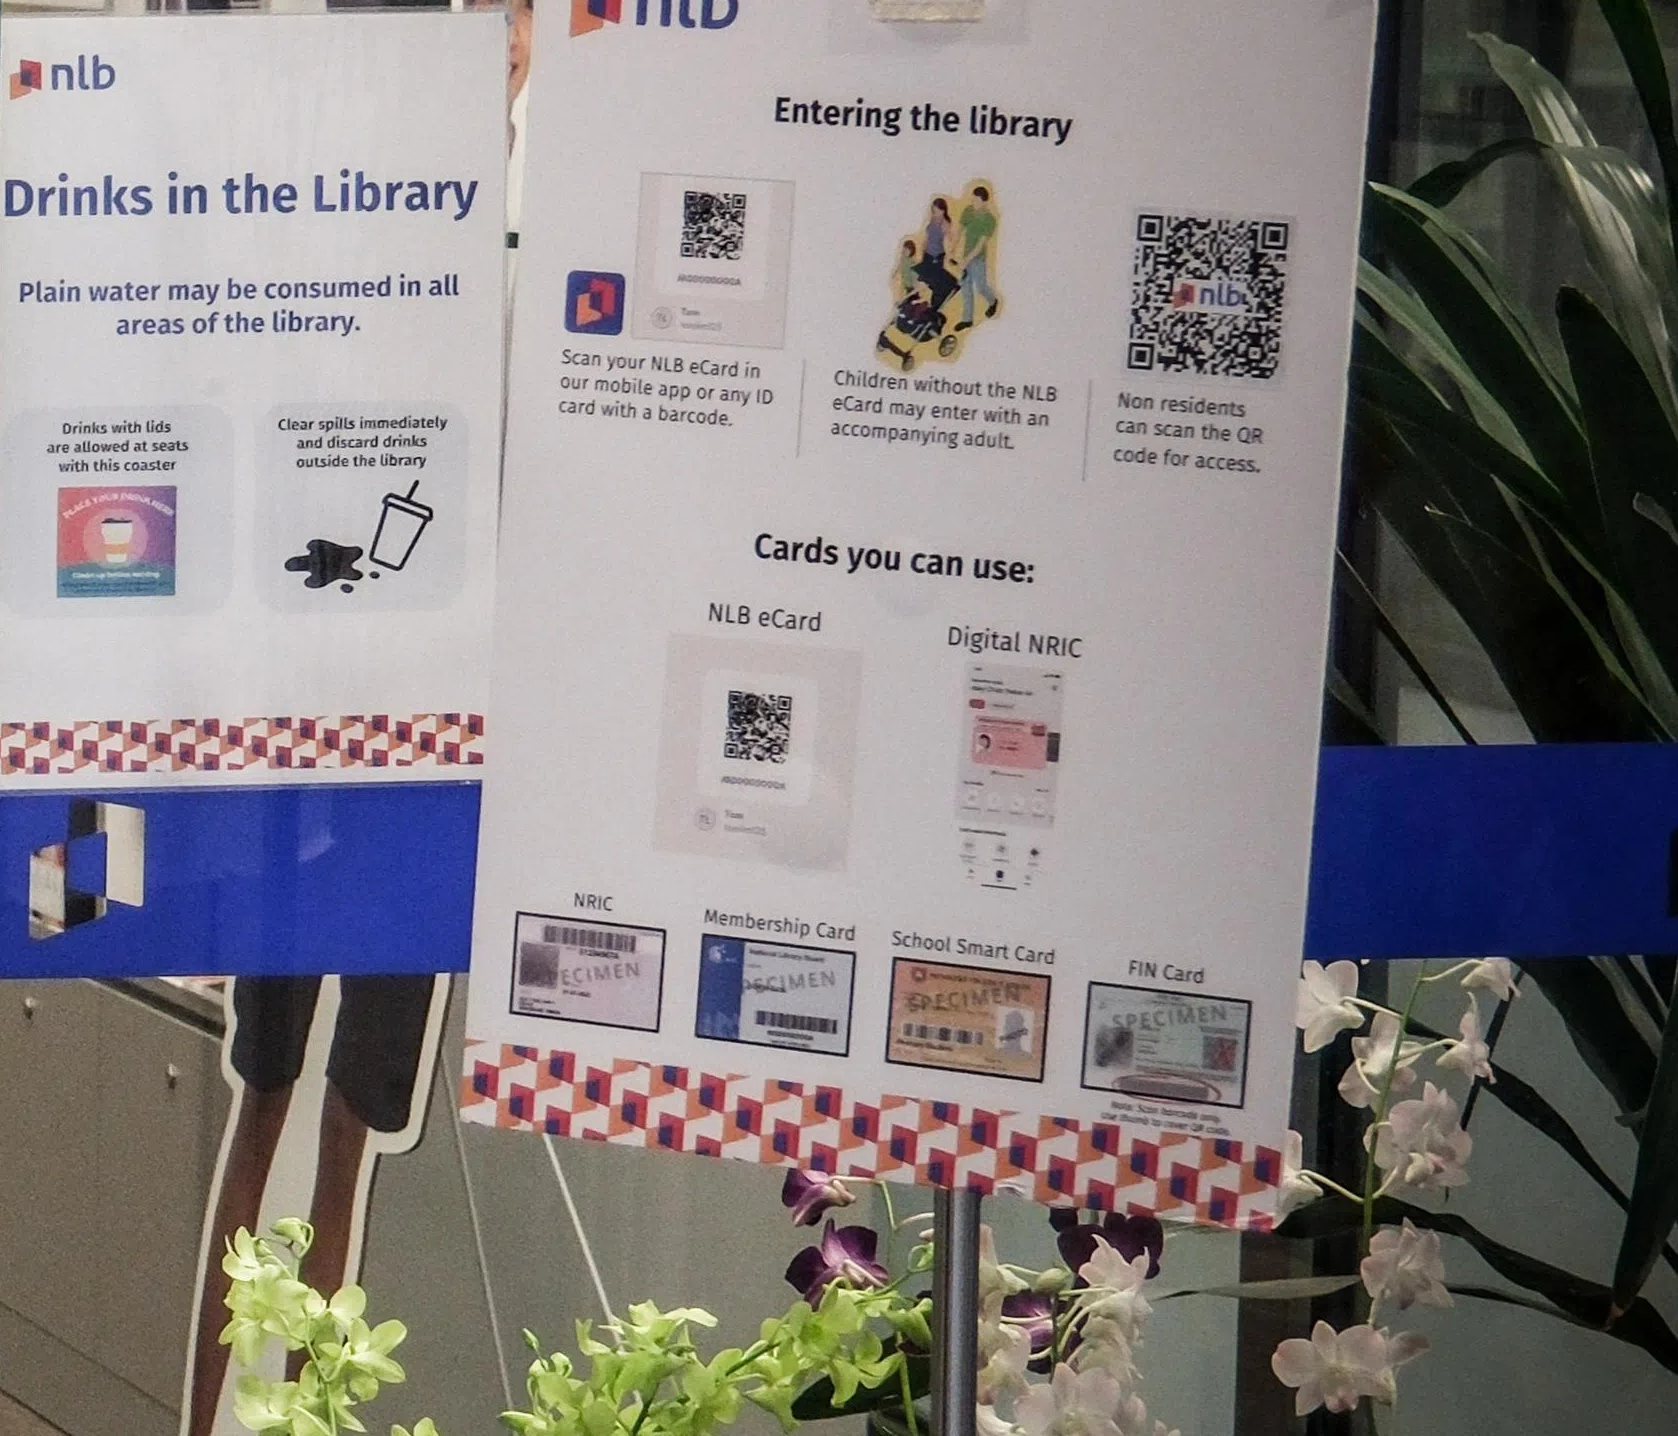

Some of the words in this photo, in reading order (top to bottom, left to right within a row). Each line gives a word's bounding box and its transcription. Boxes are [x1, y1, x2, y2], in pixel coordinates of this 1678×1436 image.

[51, 54, 116, 91] nlb
[774, 96, 903, 137] Entering
[910, 103, 960, 133] the
[969, 104, 1074, 146] library
[4, 172, 153, 217] Drinks
[167, 171, 208, 215] in
[221, 172, 298, 215] the
[314, 168, 479, 222] Library
[19, 279, 81, 303] Plain
[88, 281, 161, 302] water
[168, 283, 221, 306] may
[227, 277, 258, 300] be
[264, 275, 392, 300] consumed
[399, 273, 421, 297] in
[428, 273, 460, 297] all
[116, 314, 179, 335] areas
[186, 310, 217, 334] of
[223, 311, 265, 334] the
[272, 308, 361, 337] library.
[561, 348, 602, 367] Scan
[606, 355, 647, 372] your
[651, 355, 685, 373] NLB
[689, 359, 739, 378] eCard
[744, 361, 761, 379] in
[560, 376, 589, 390] our
[594, 377, 653, 396] mobile
[658, 384, 691, 402] app
[696, 386, 716, 400] or
[719, 388, 751, 407] any
[756, 388, 774, 405] ID
[834, 369, 909, 390] Children
[913, 375, 983, 397] without
[987, 381, 1017, 400] the
[1022, 384, 1058, 403] NLB
[558, 399, 596, 416] card
[600, 400, 637, 419] with
[642, 407, 652, 421] a
[658, 405, 733, 427] barcode.
[832, 395, 883, 414] eCard
[889, 402, 926, 421] may
[930, 405, 979, 421] enter
[983, 406, 1022, 425] with
[1027, 413, 1050, 427] an
[1117, 391, 1155, 410] Non
[1160, 395, 1247, 418] residents
[62, 420, 108, 435] Drinks
[111, 419, 142, 434] with
[146, 419, 172, 434] lids
[277, 418, 315, 431] Clear
[318, 416, 356, 433] spills
[359, 415, 448, 432] immediately
[830, 422, 960, 450] accompanying
[962, 430, 1015, 450] adult.
[1115, 420, 1148, 435] can
[1153, 423, 1196, 439] scan
[1200, 423, 1232, 442] the
[1236, 426, 1264, 445] QR
[46, 443, 70, 454] are
[73, 439, 130, 453] allowed
[133, 440, 149, 453] at
[151, 440, 189, 452] seats
[296, 436, 323, 450] and
[326, 435, 379, 449] discard
[382, 434, 428, 448] drinks
[58, 458, 89, 473] with
[93, 458, 121, 472] this
[123, 459, 177, 472] coaster
[296, 454, 349, 469] outside
[352, 454, 377, 468] the
[380, 452, 427, 469] library
[1113, 447, 1158, 465] code
[1163, 448, 1191, 467] for
[1194, 455, 1261, 474] access.
[754, 533, 839, 566] Cards
[847, 546, 901, 574] you
[910, 552, 964, 577] can
[973, 558, 1034, 584] use:
[708, 602, 751, 625] NLB
[758, 608, 822, 632] eCard
[947, 625, 1021, 654] Digital
[1028, 634, 1083, 659] NRIC
[574, 892, 613, 912] NRIC
[704, 909, 810, 939] Membership
[815, 922, 856, 942] Card
[891, 930, 951, 952] School
[956, 938, 1009, 960] Smart
[1014, 945, 1056, 965] Card
[1128, 959, 1158, 979] FIN
[1162, 964, 1205, 985] Card
